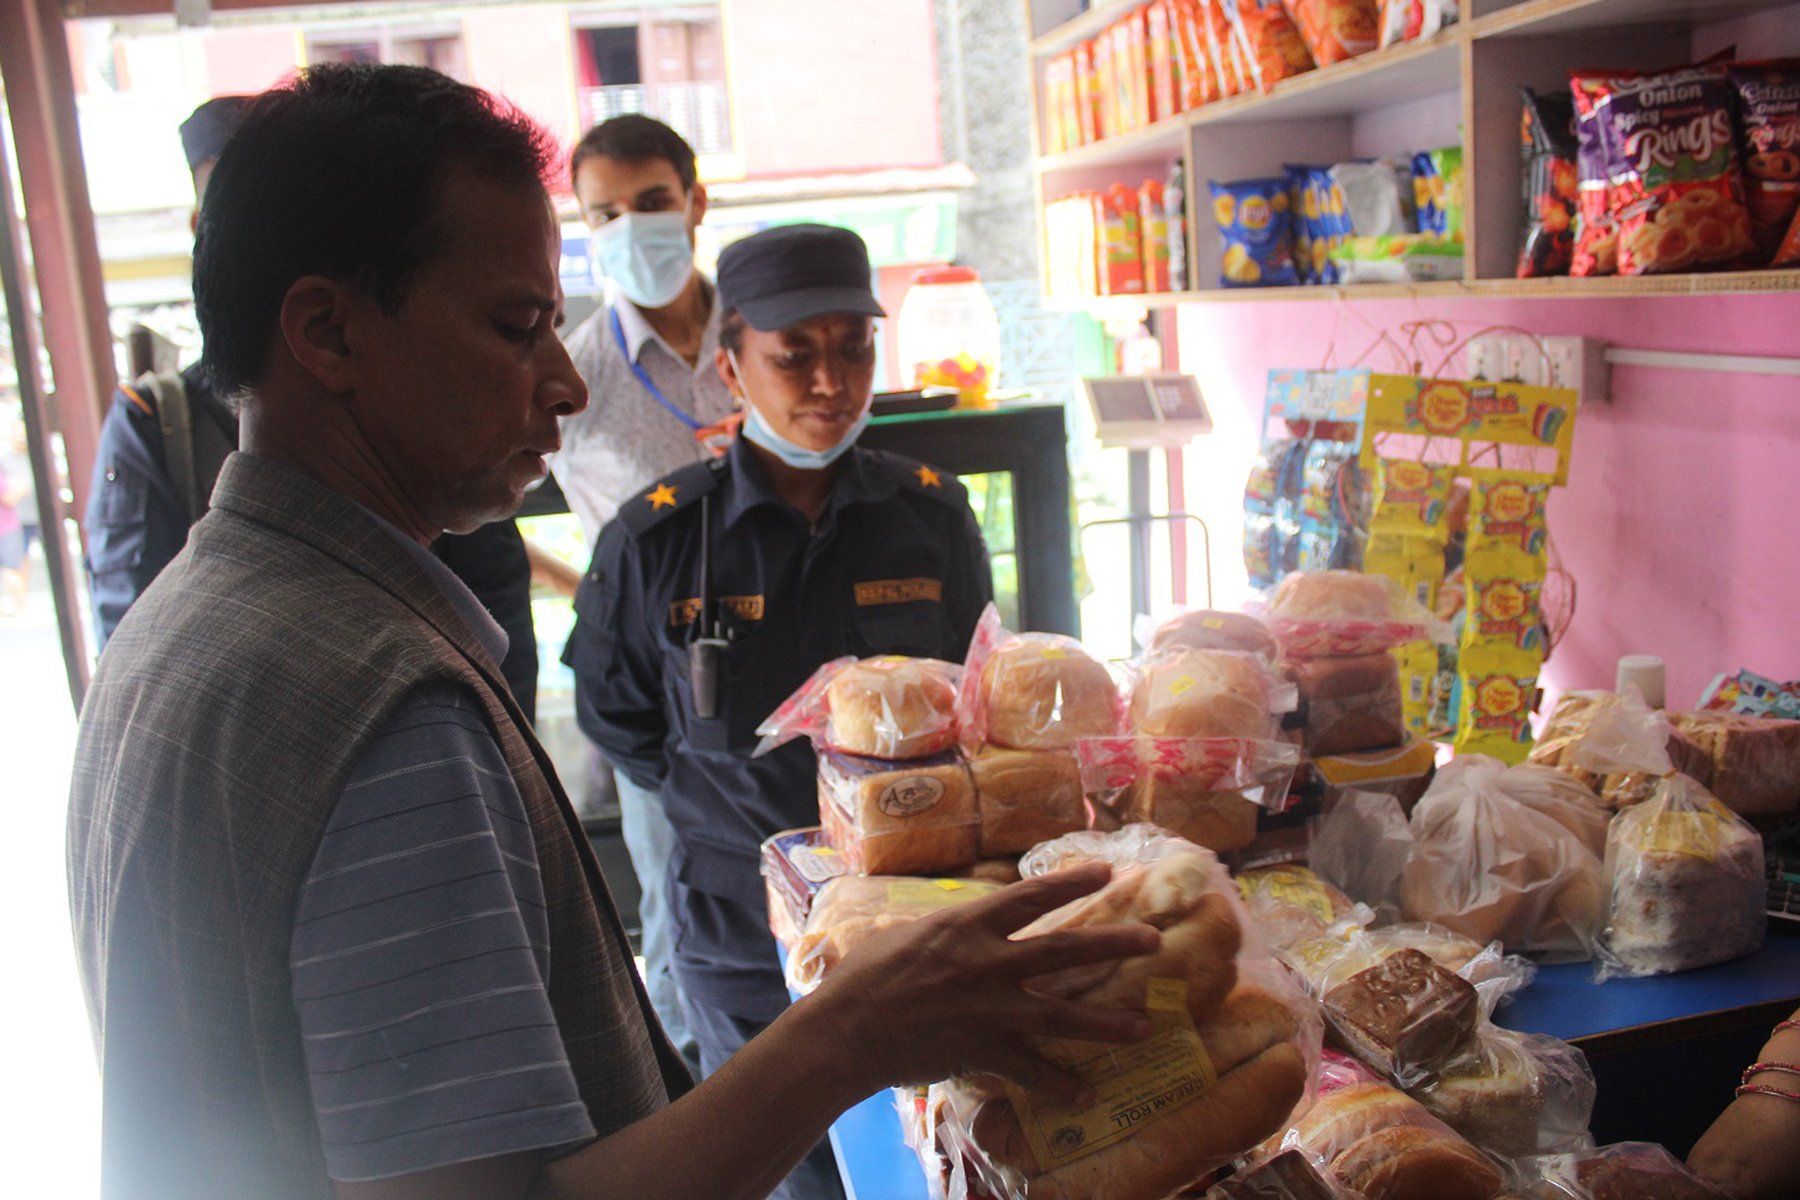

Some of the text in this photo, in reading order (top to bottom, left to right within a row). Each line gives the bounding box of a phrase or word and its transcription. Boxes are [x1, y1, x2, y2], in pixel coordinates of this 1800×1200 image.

[1639, 84, 1703, 107] Onion
[1613, 108, 1660, 131] Spicy
[1624, 109, 1732, 172] Rings
[1110, 1103, 1153, 1131] ROLL
